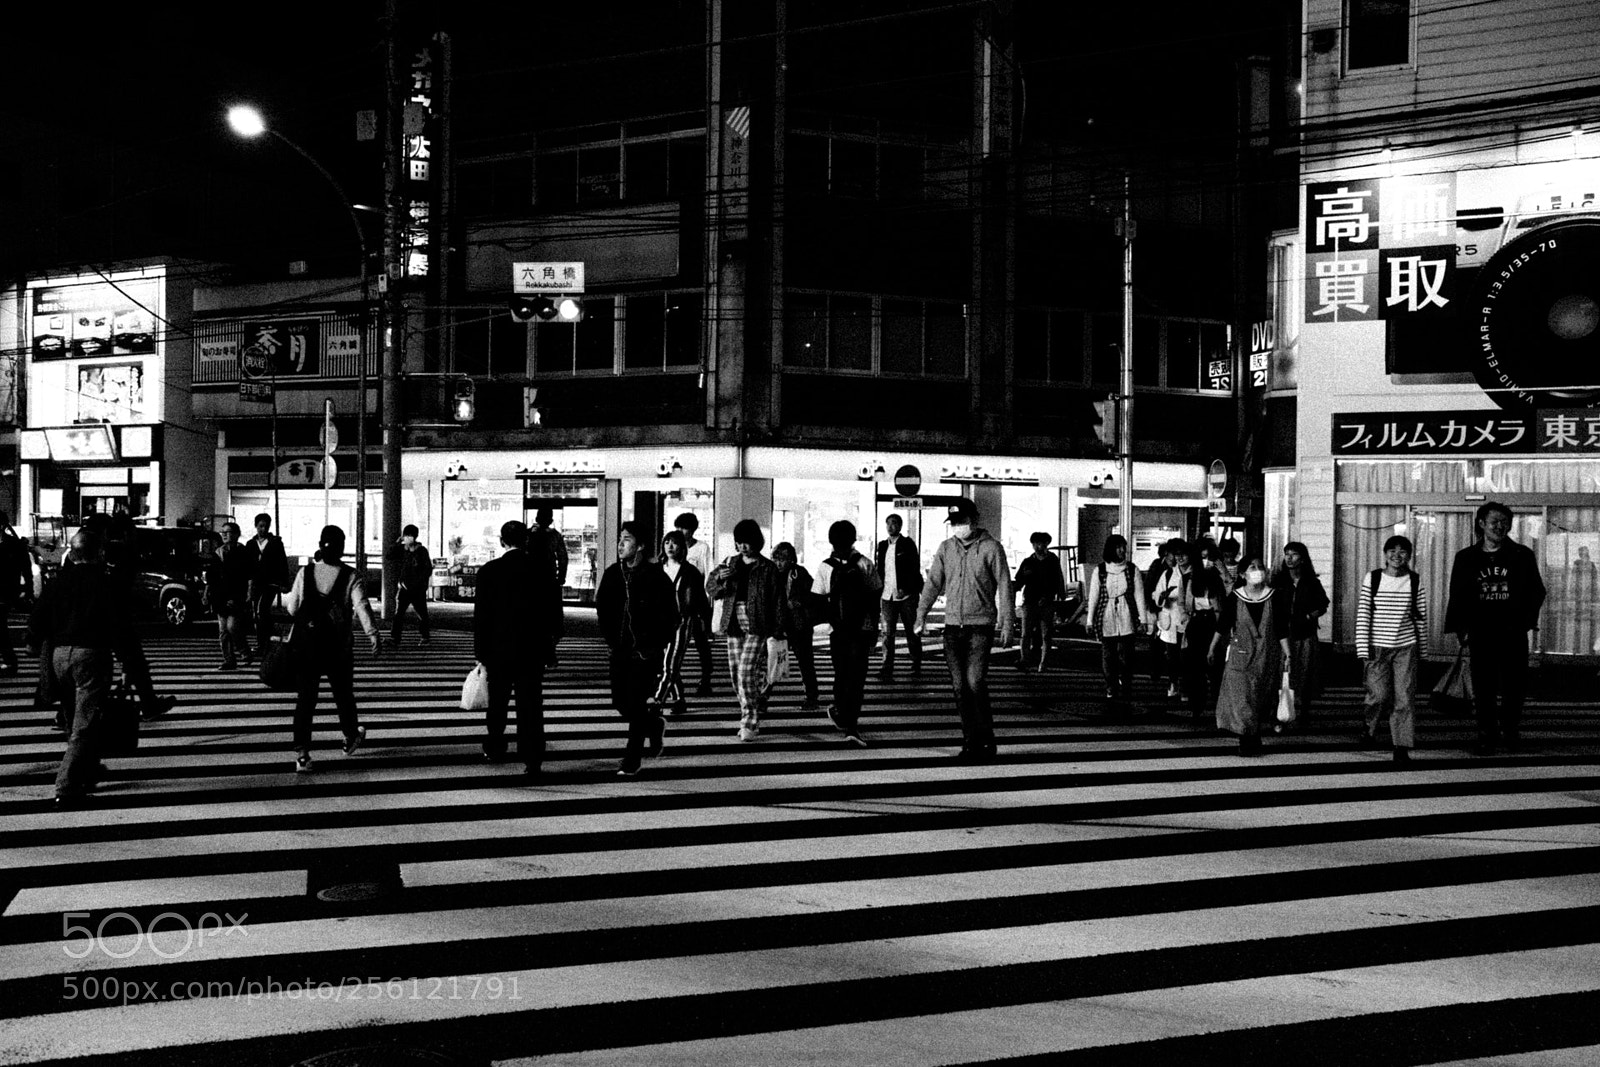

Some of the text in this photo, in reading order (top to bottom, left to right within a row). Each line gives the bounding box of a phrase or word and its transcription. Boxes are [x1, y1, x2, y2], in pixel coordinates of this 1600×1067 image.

[521, 266, 576, 280] 六角橋
[1340, 419, 1526, 449] フィルムカメラ
